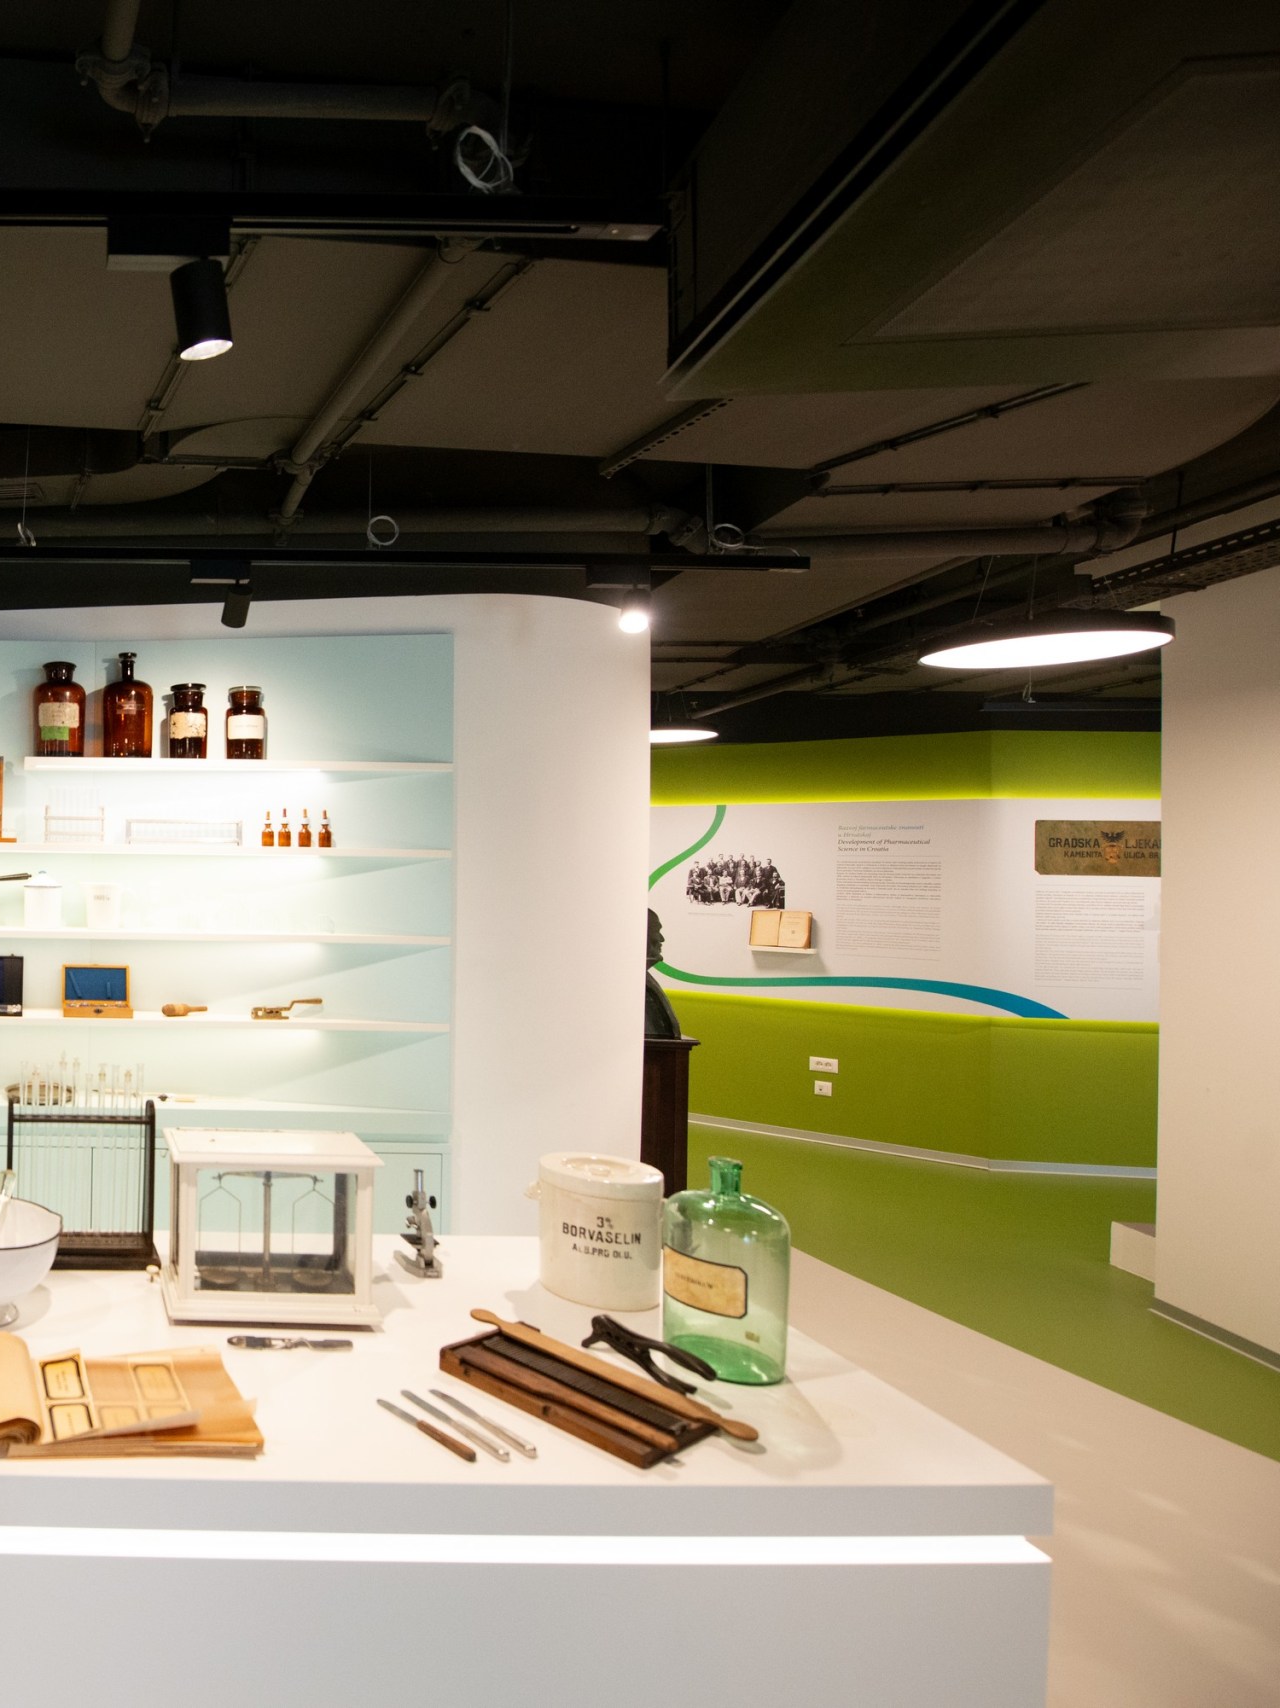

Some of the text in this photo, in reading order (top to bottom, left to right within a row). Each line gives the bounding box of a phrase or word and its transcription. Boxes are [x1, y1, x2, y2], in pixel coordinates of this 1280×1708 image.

[1048, 837, 1161, 849] GRADSKA LJEKA
[1063, 850, 1103, 859] KAMENITA
[1123, 851, 1146, 859] ULICA
[562, 1221, 642, 1245] BORVASELIN
